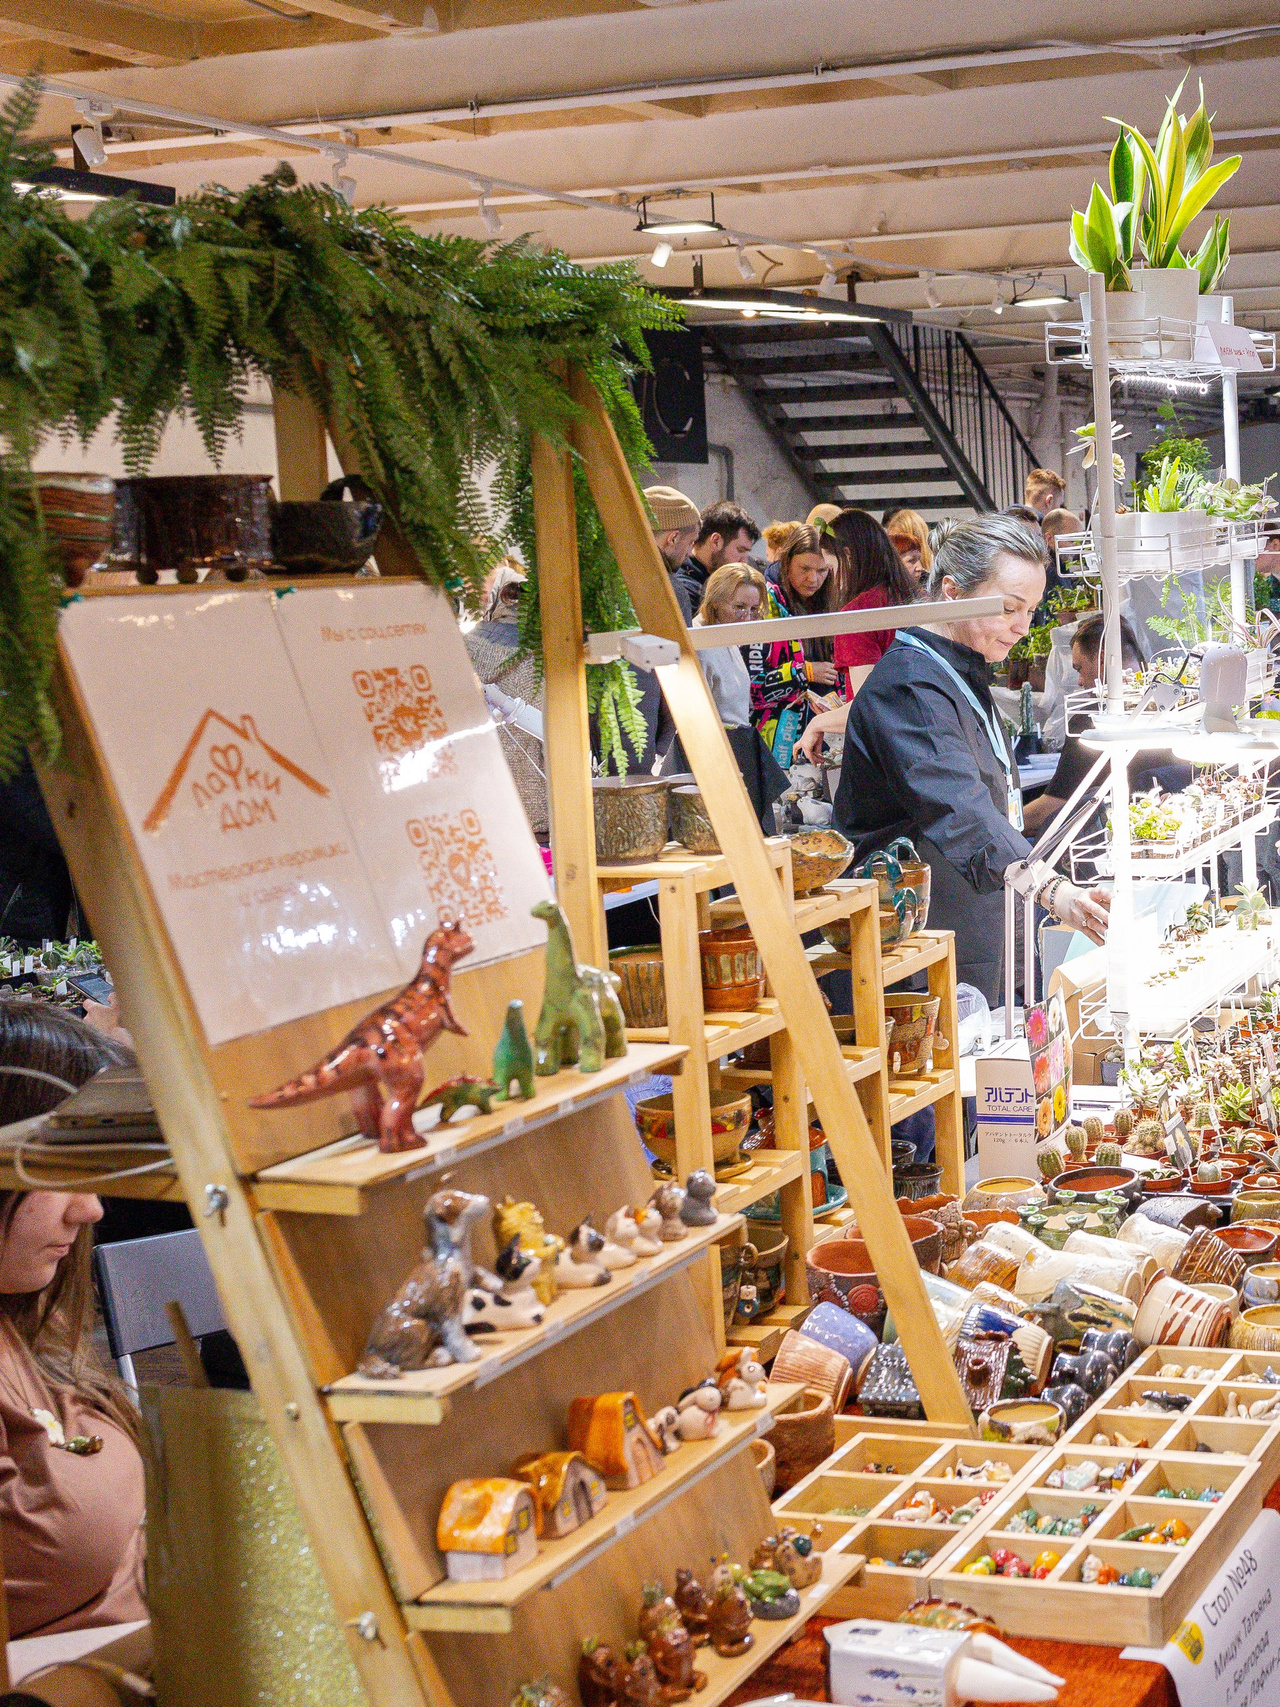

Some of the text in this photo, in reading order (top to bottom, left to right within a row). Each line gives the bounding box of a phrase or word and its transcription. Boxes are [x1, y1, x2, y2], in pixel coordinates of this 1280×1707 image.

[1202, 1548, 1258, 1627] Стол №48
[1241, 1587, 1272, 1638] Татьяна
